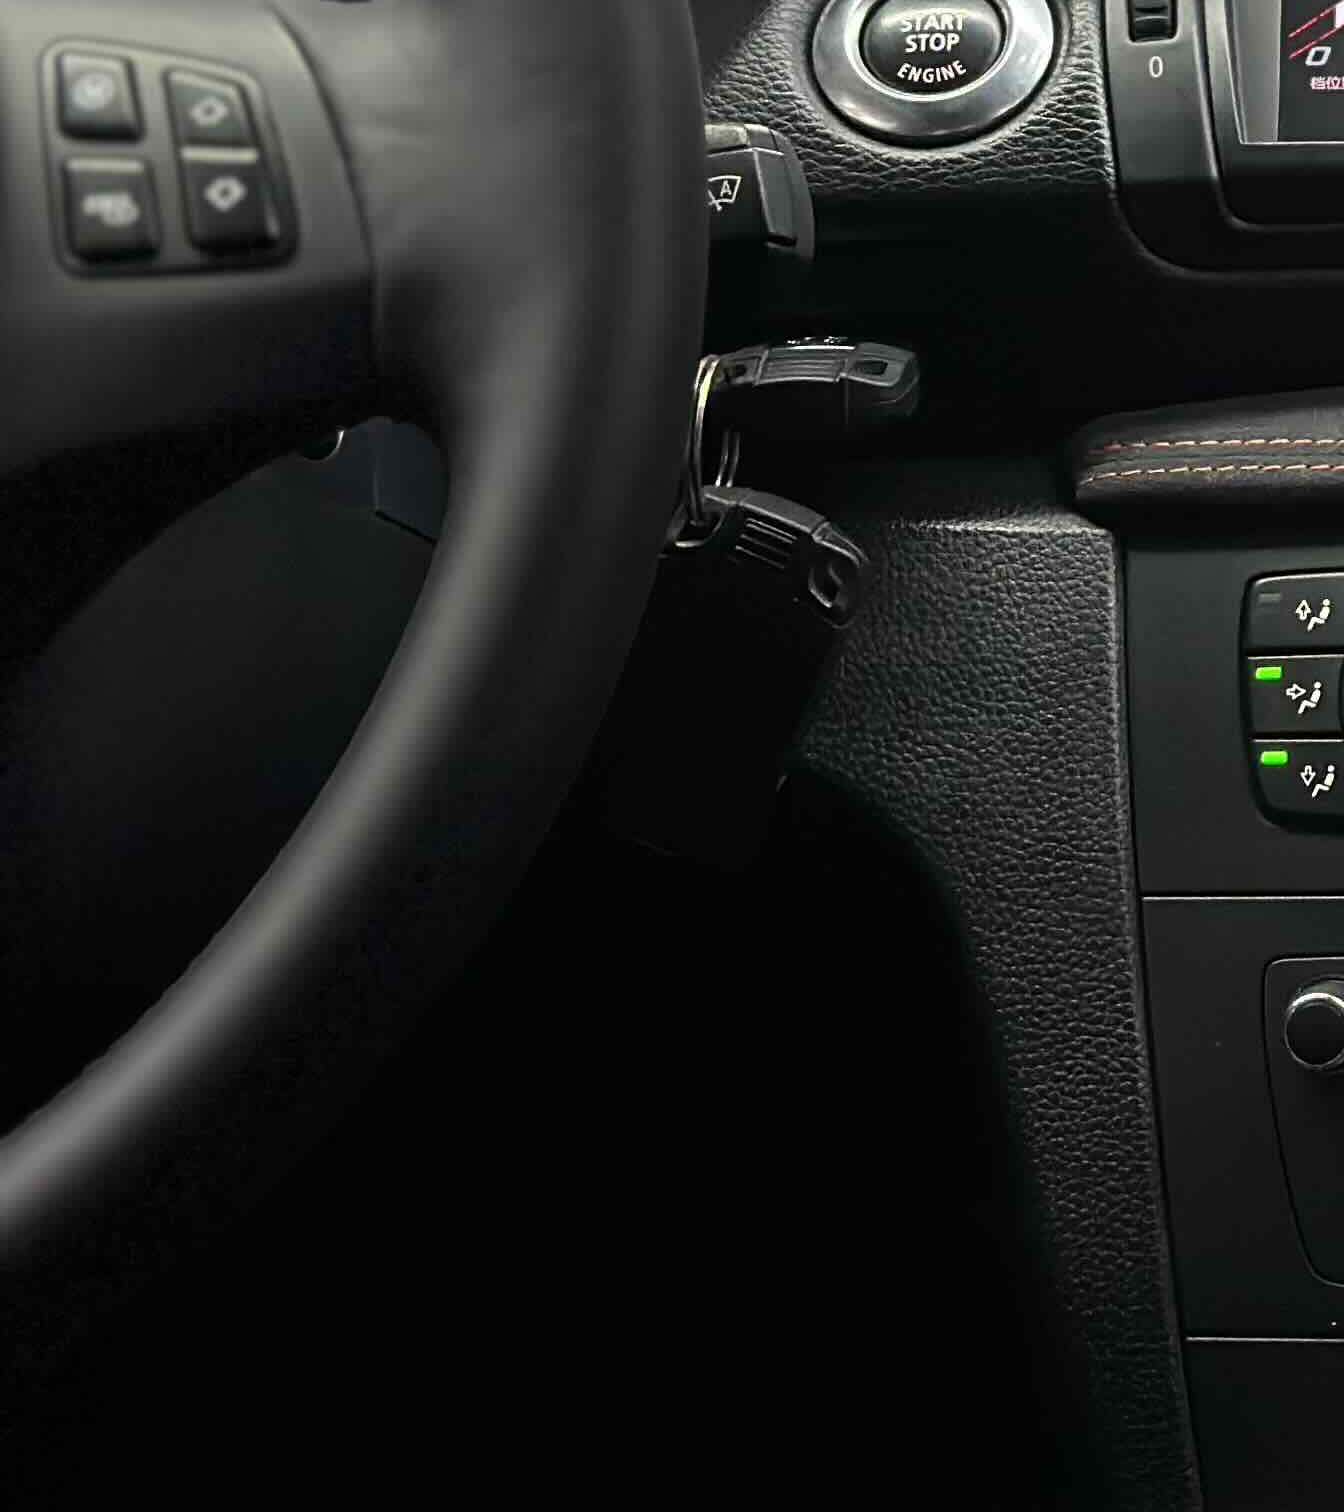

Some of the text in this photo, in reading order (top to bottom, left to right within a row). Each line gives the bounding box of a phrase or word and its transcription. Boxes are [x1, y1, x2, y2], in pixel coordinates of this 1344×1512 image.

[900, 15, 966, 33] START
[905, 34, 960, 53] STOP
[1304, 46, 1332, 66] 0
[897, 60, 967, 84] ENGINE
